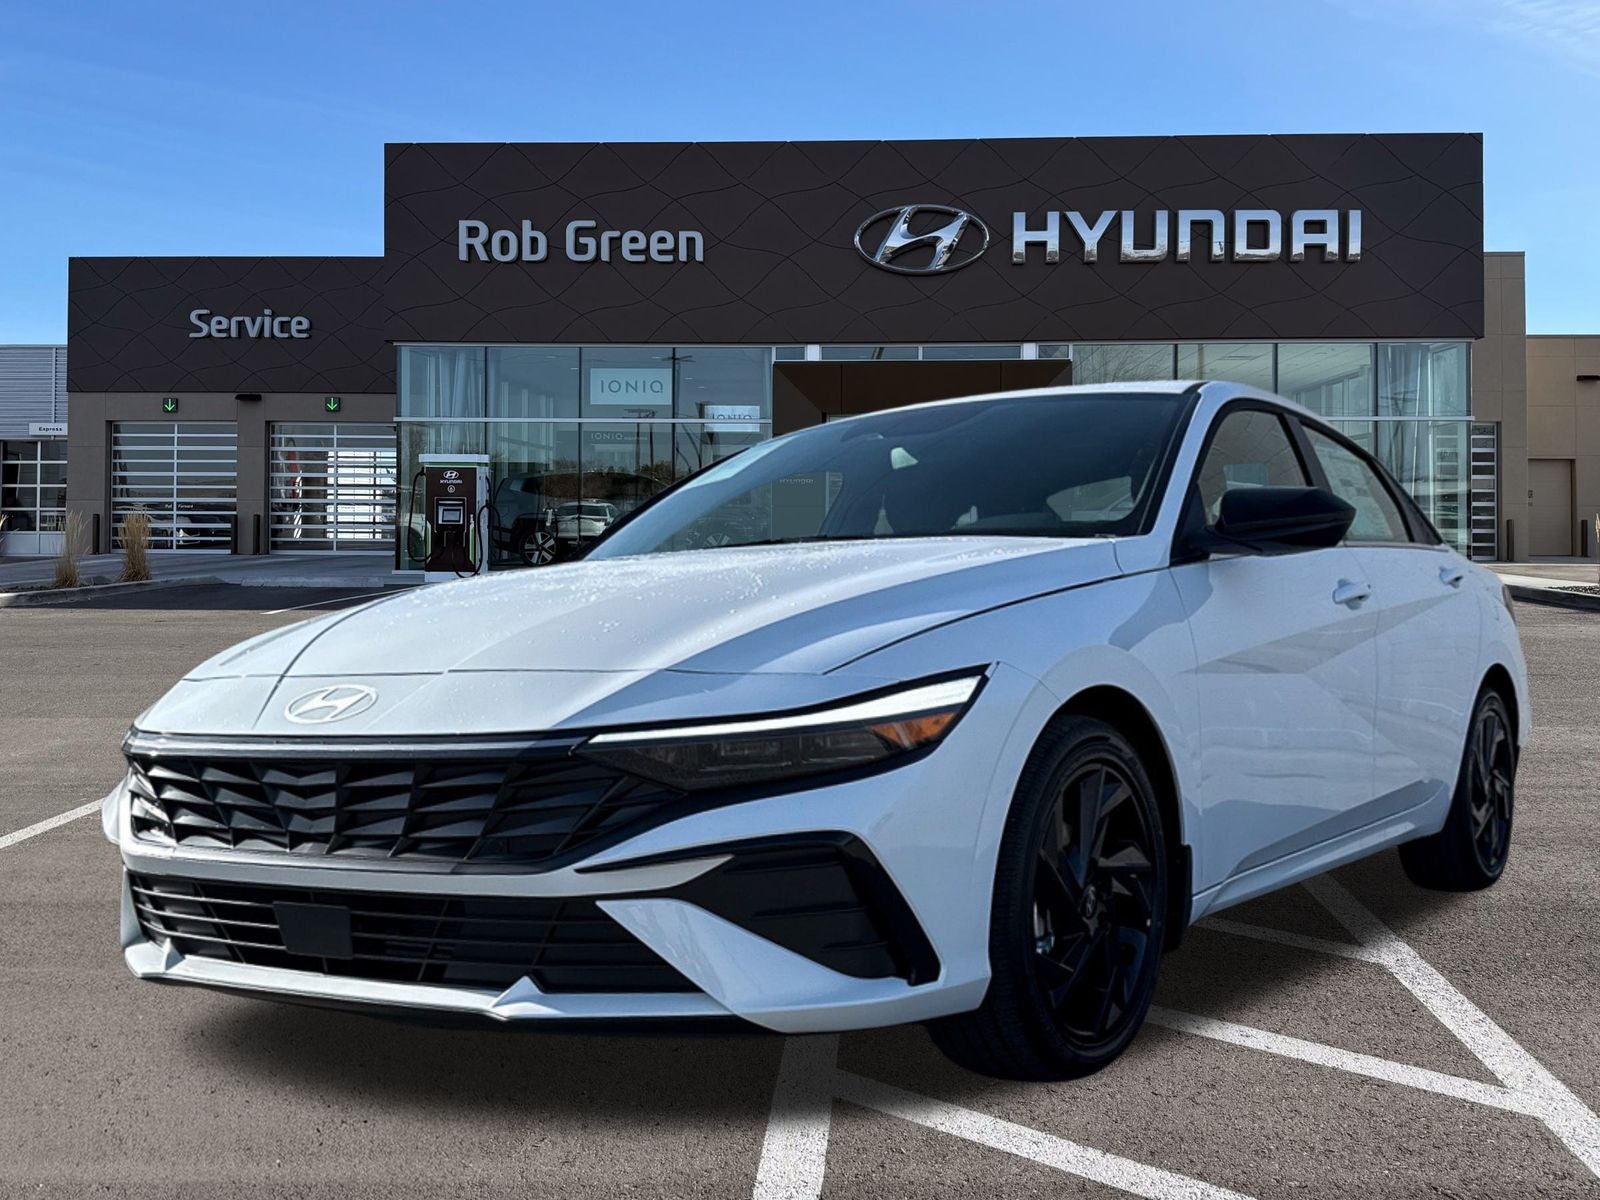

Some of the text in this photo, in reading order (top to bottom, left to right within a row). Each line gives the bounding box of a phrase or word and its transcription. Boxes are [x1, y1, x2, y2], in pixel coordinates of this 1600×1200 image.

[458, 219, 705, 263] Rob Green
[1011, 208, 1363, 264] HYUNDAI
[188, 308, 311, 339] Service
[600, 379, 664, 394] IONIQ
